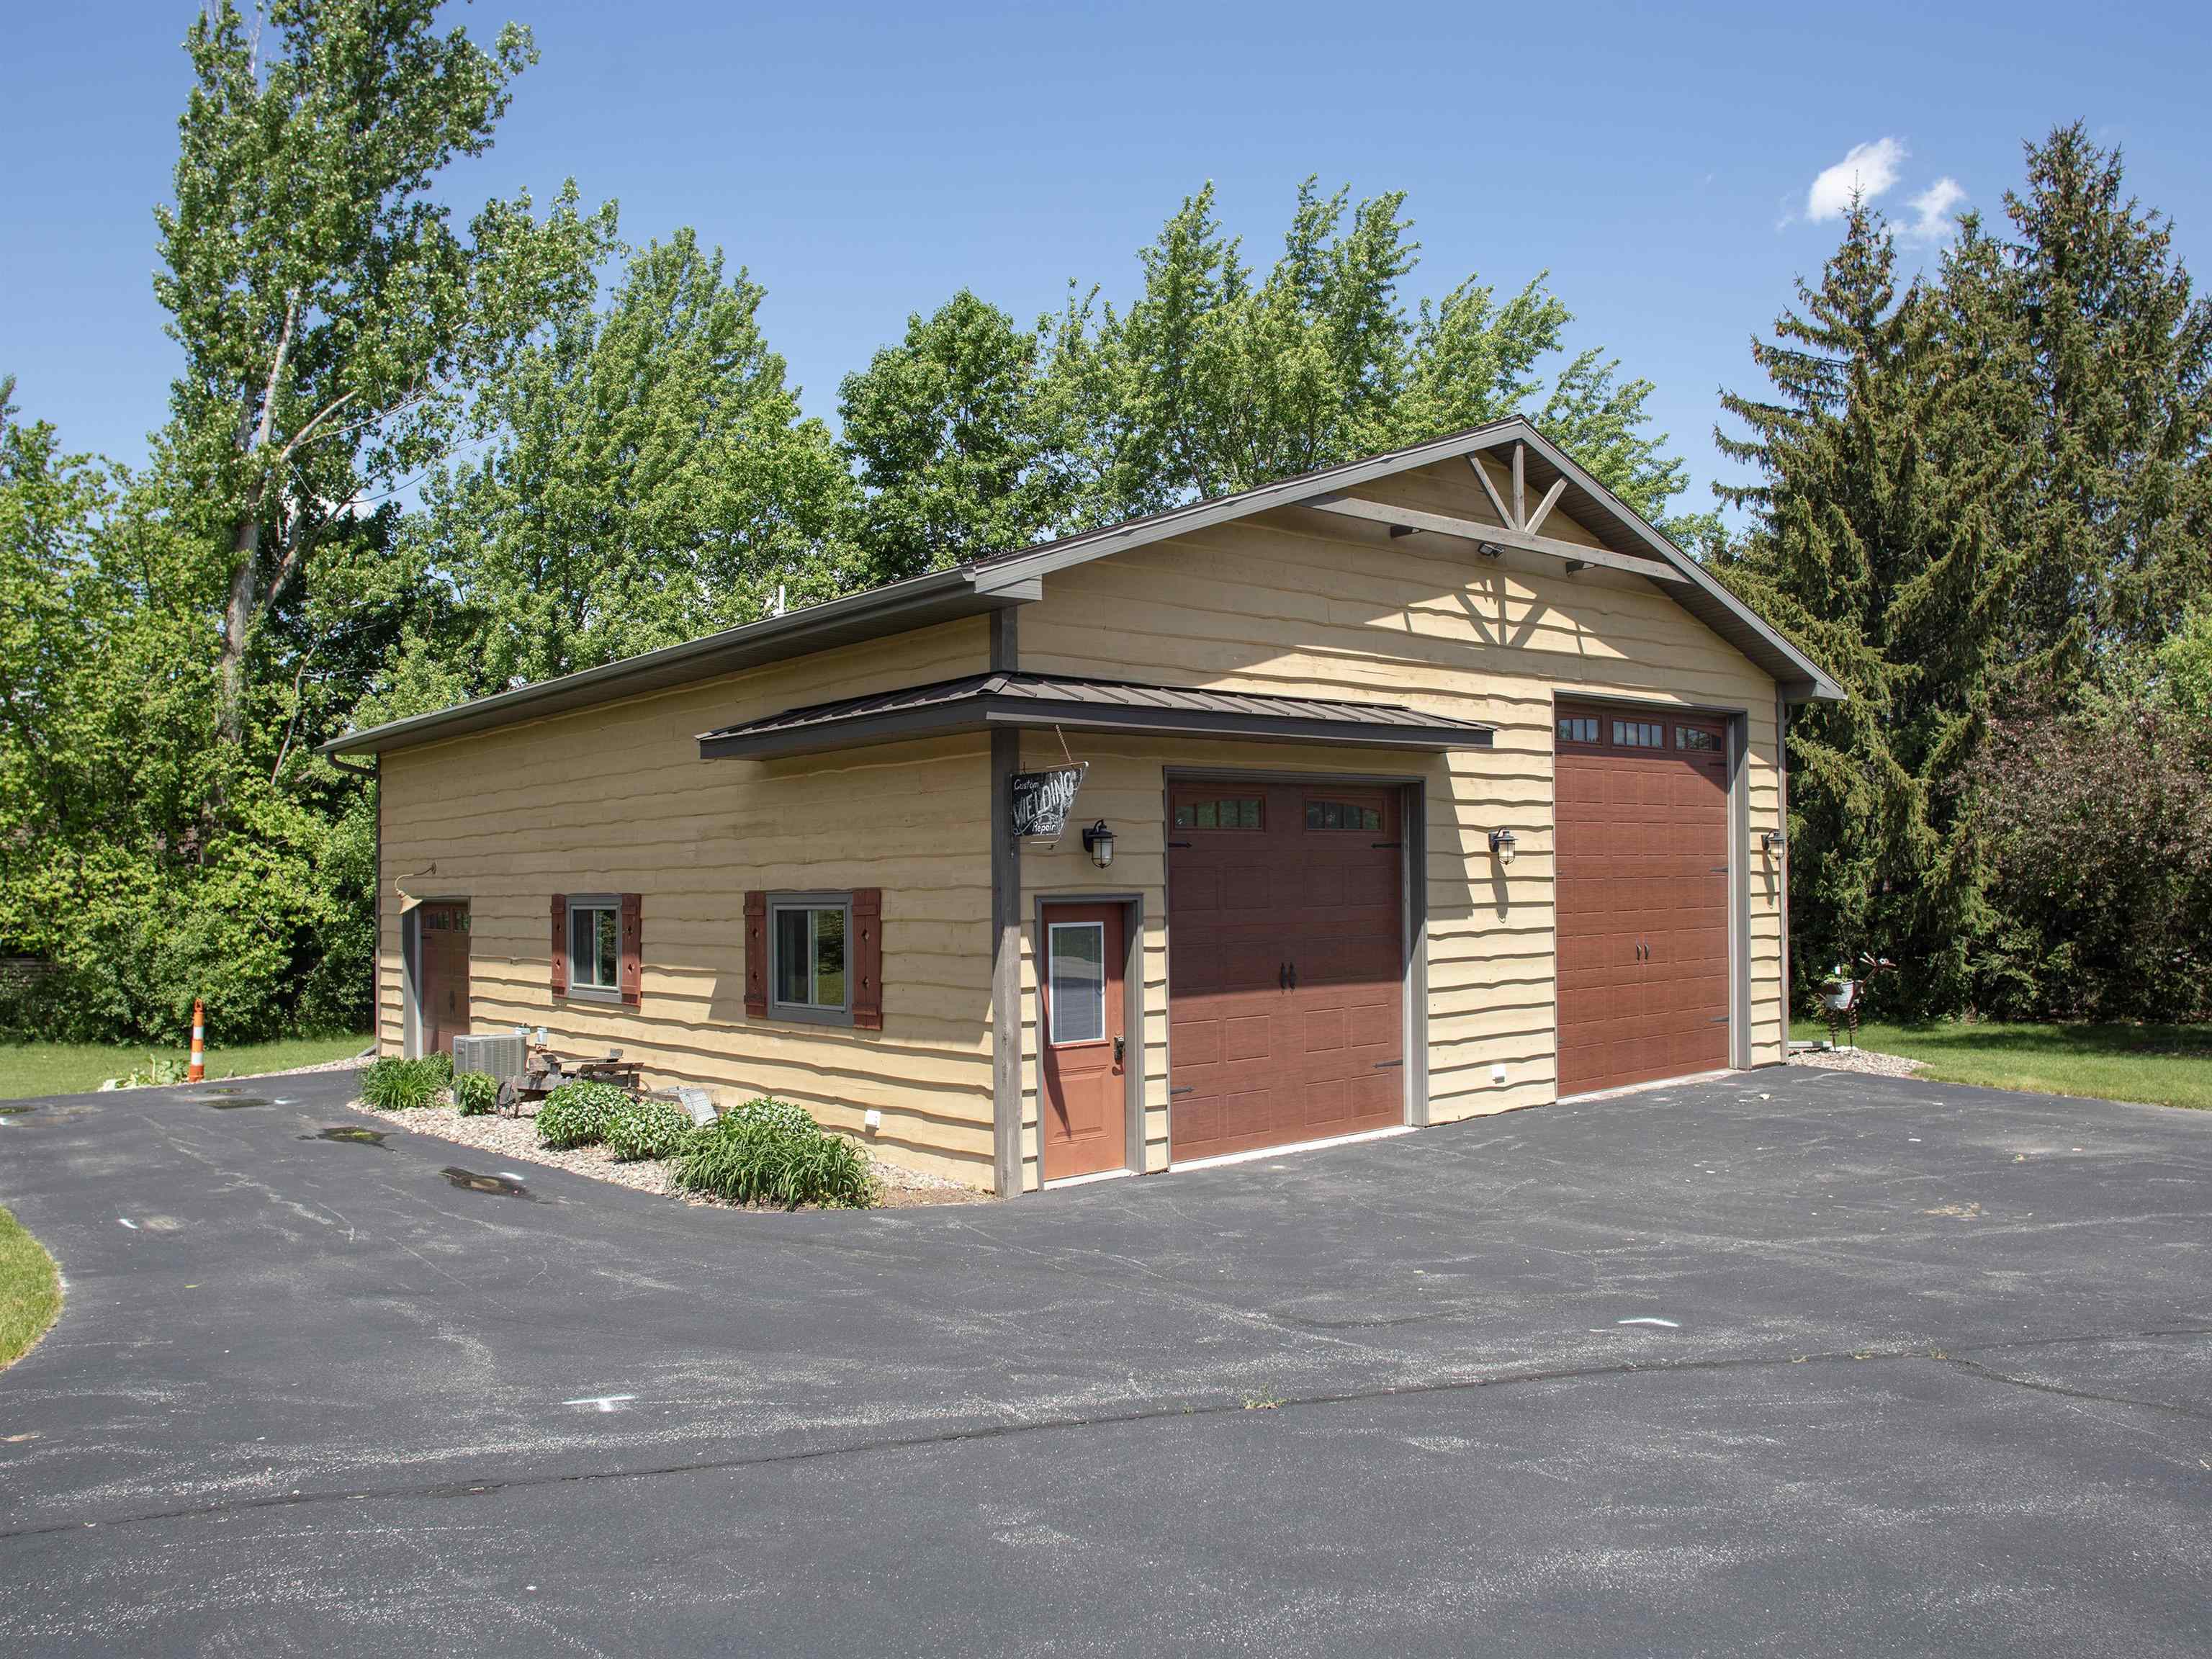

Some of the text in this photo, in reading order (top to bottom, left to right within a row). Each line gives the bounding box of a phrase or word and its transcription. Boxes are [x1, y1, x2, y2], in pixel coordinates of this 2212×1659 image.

[1014, 779, 1039, 790] Custom
[1014, 771, 1074, 827] WELDING
[1032, 822, 1056, 835] Repair
